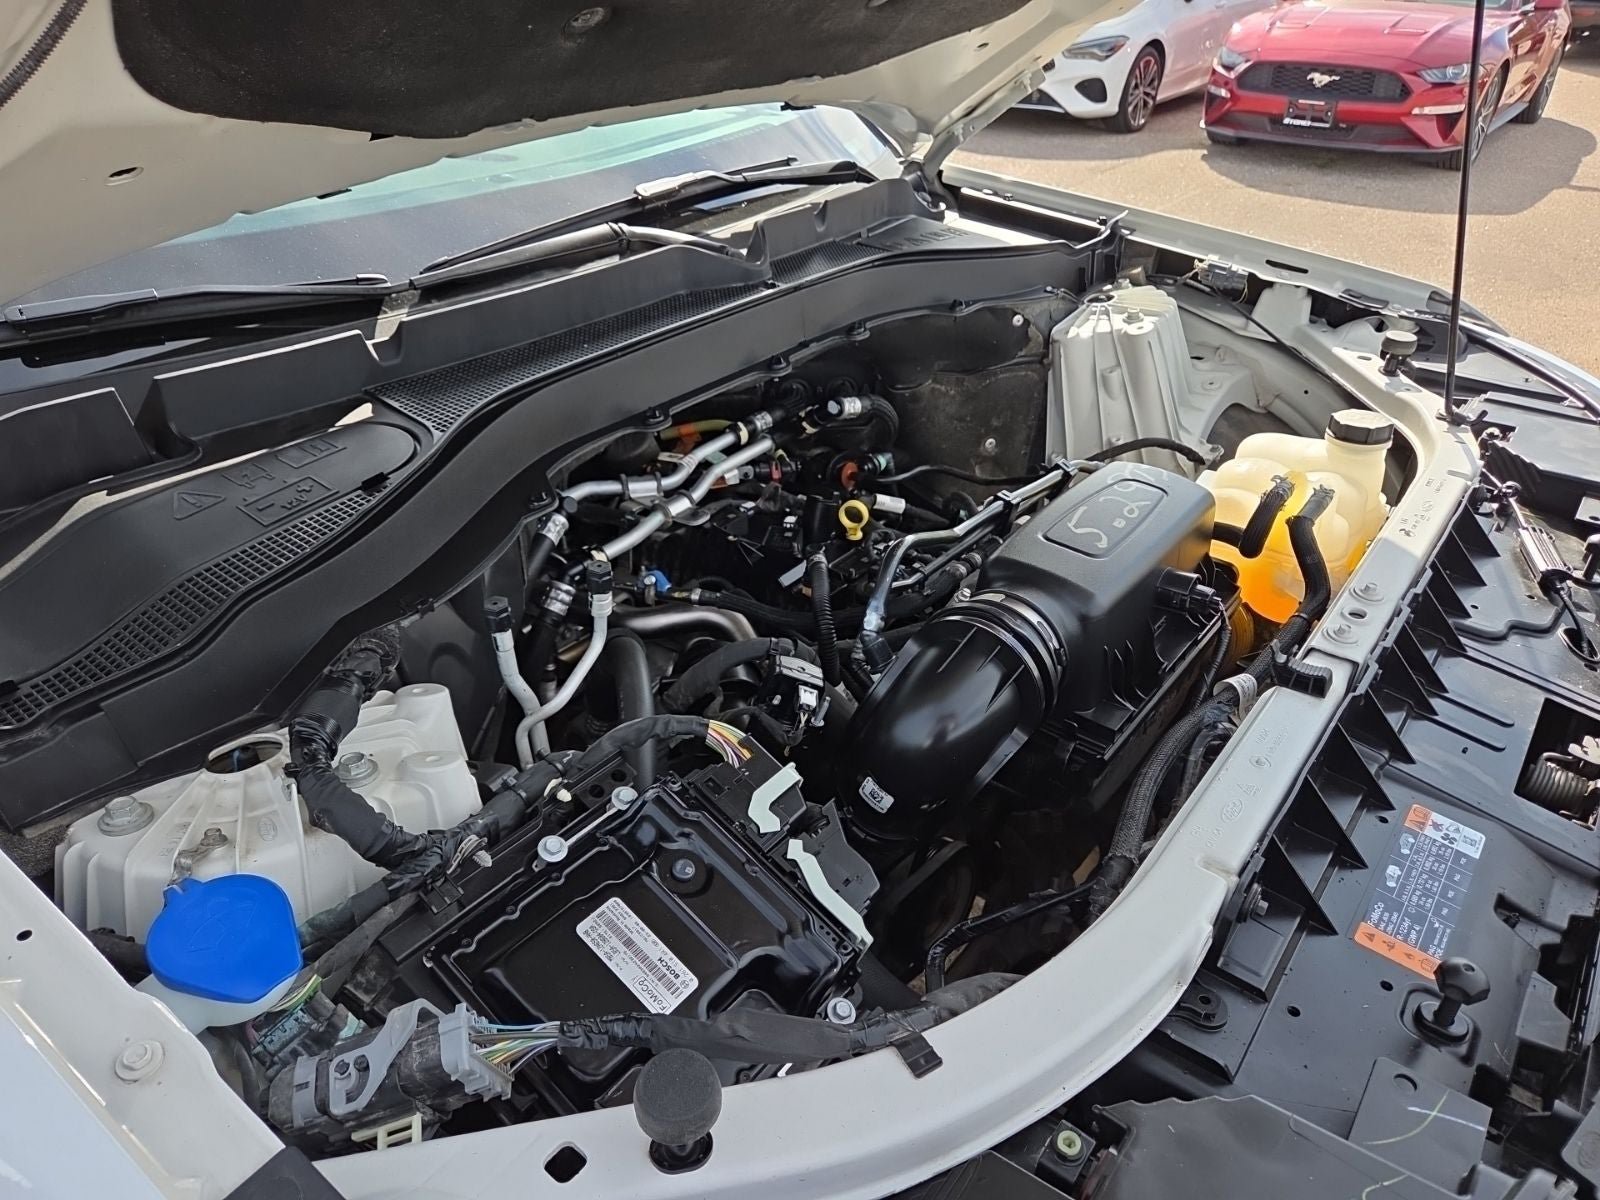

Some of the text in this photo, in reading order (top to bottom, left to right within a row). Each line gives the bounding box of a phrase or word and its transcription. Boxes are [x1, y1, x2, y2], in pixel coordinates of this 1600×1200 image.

[1366, 899, 1385, 928] FoMoCo
[1395, 916, 1413, 941] R-1234yf
[656, 955, 681, 980] BOSCH
[636, 978, 668, 1012] FoMoCo
